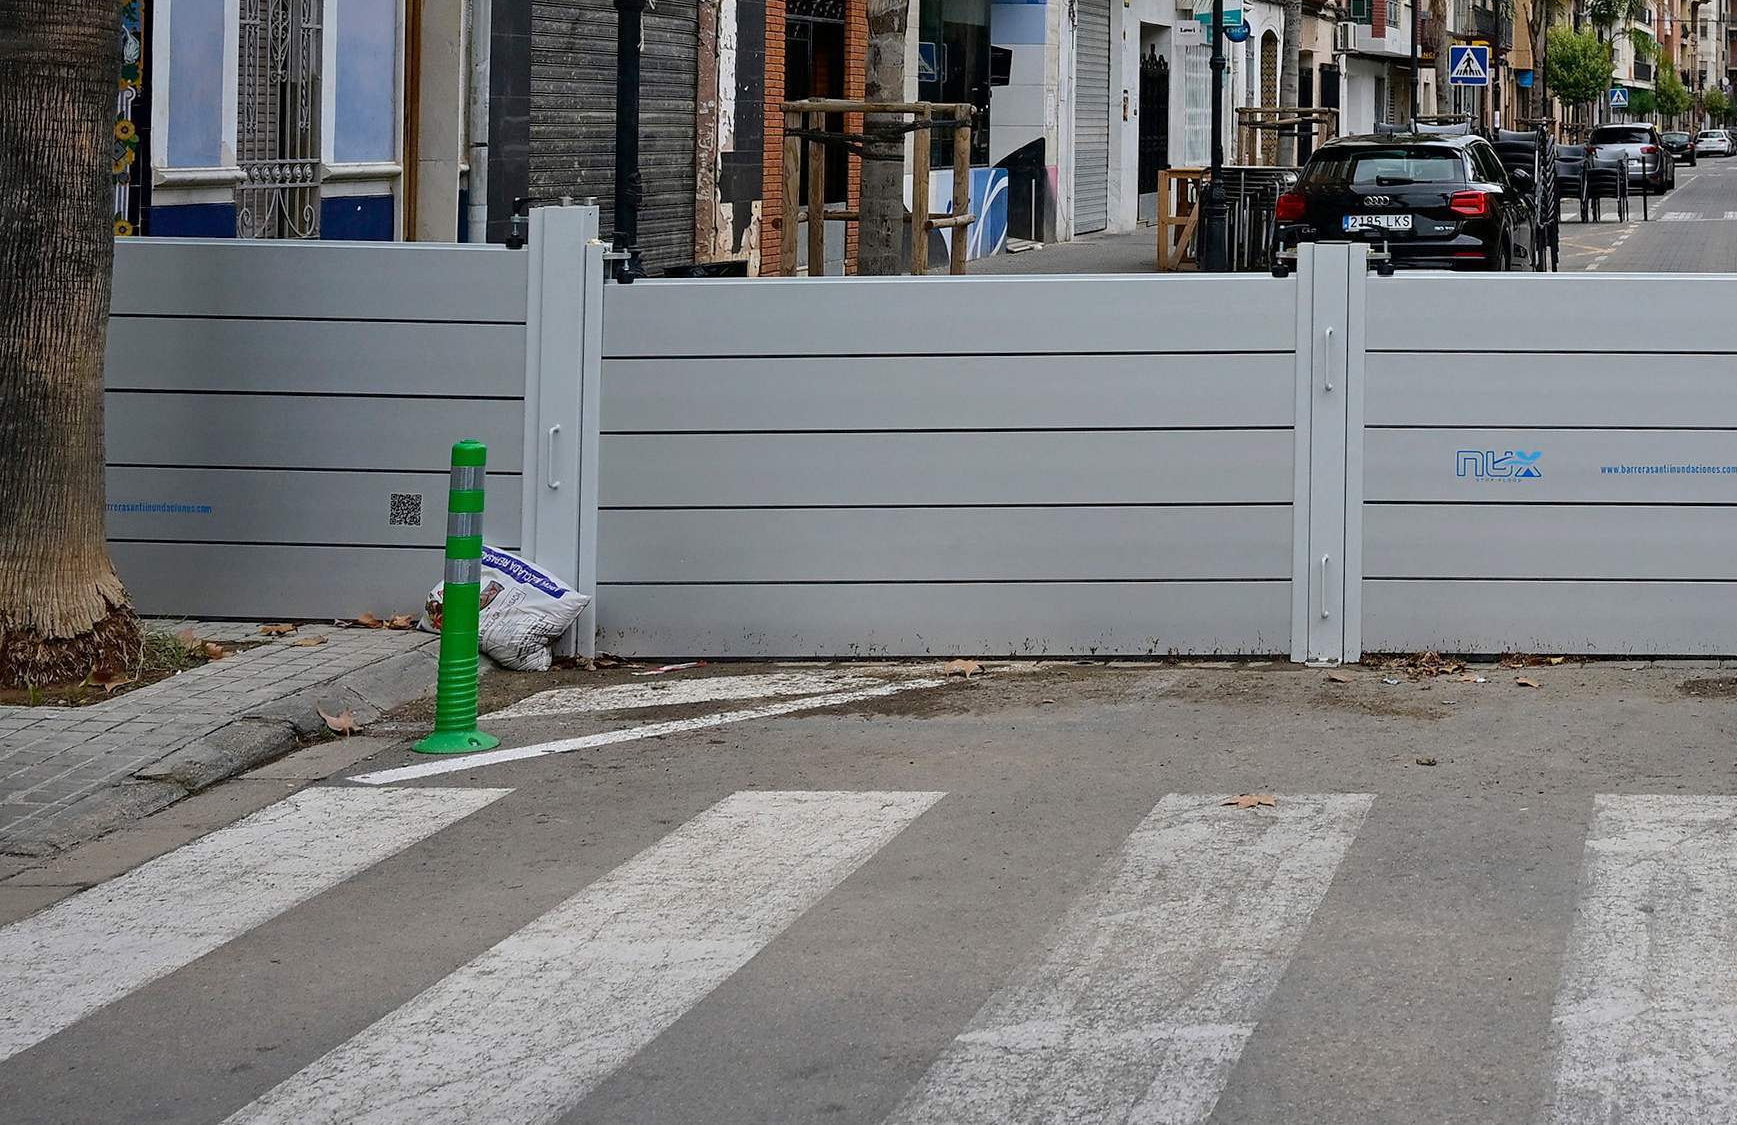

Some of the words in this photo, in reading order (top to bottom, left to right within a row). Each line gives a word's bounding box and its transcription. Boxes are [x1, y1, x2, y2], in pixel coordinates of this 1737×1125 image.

[1350, 216, 1382, 228] 2185
[1386, 215, 1410, 228] LKS
[1600, 463, 1737, 475] www.barrerasantiinundaciones.com
